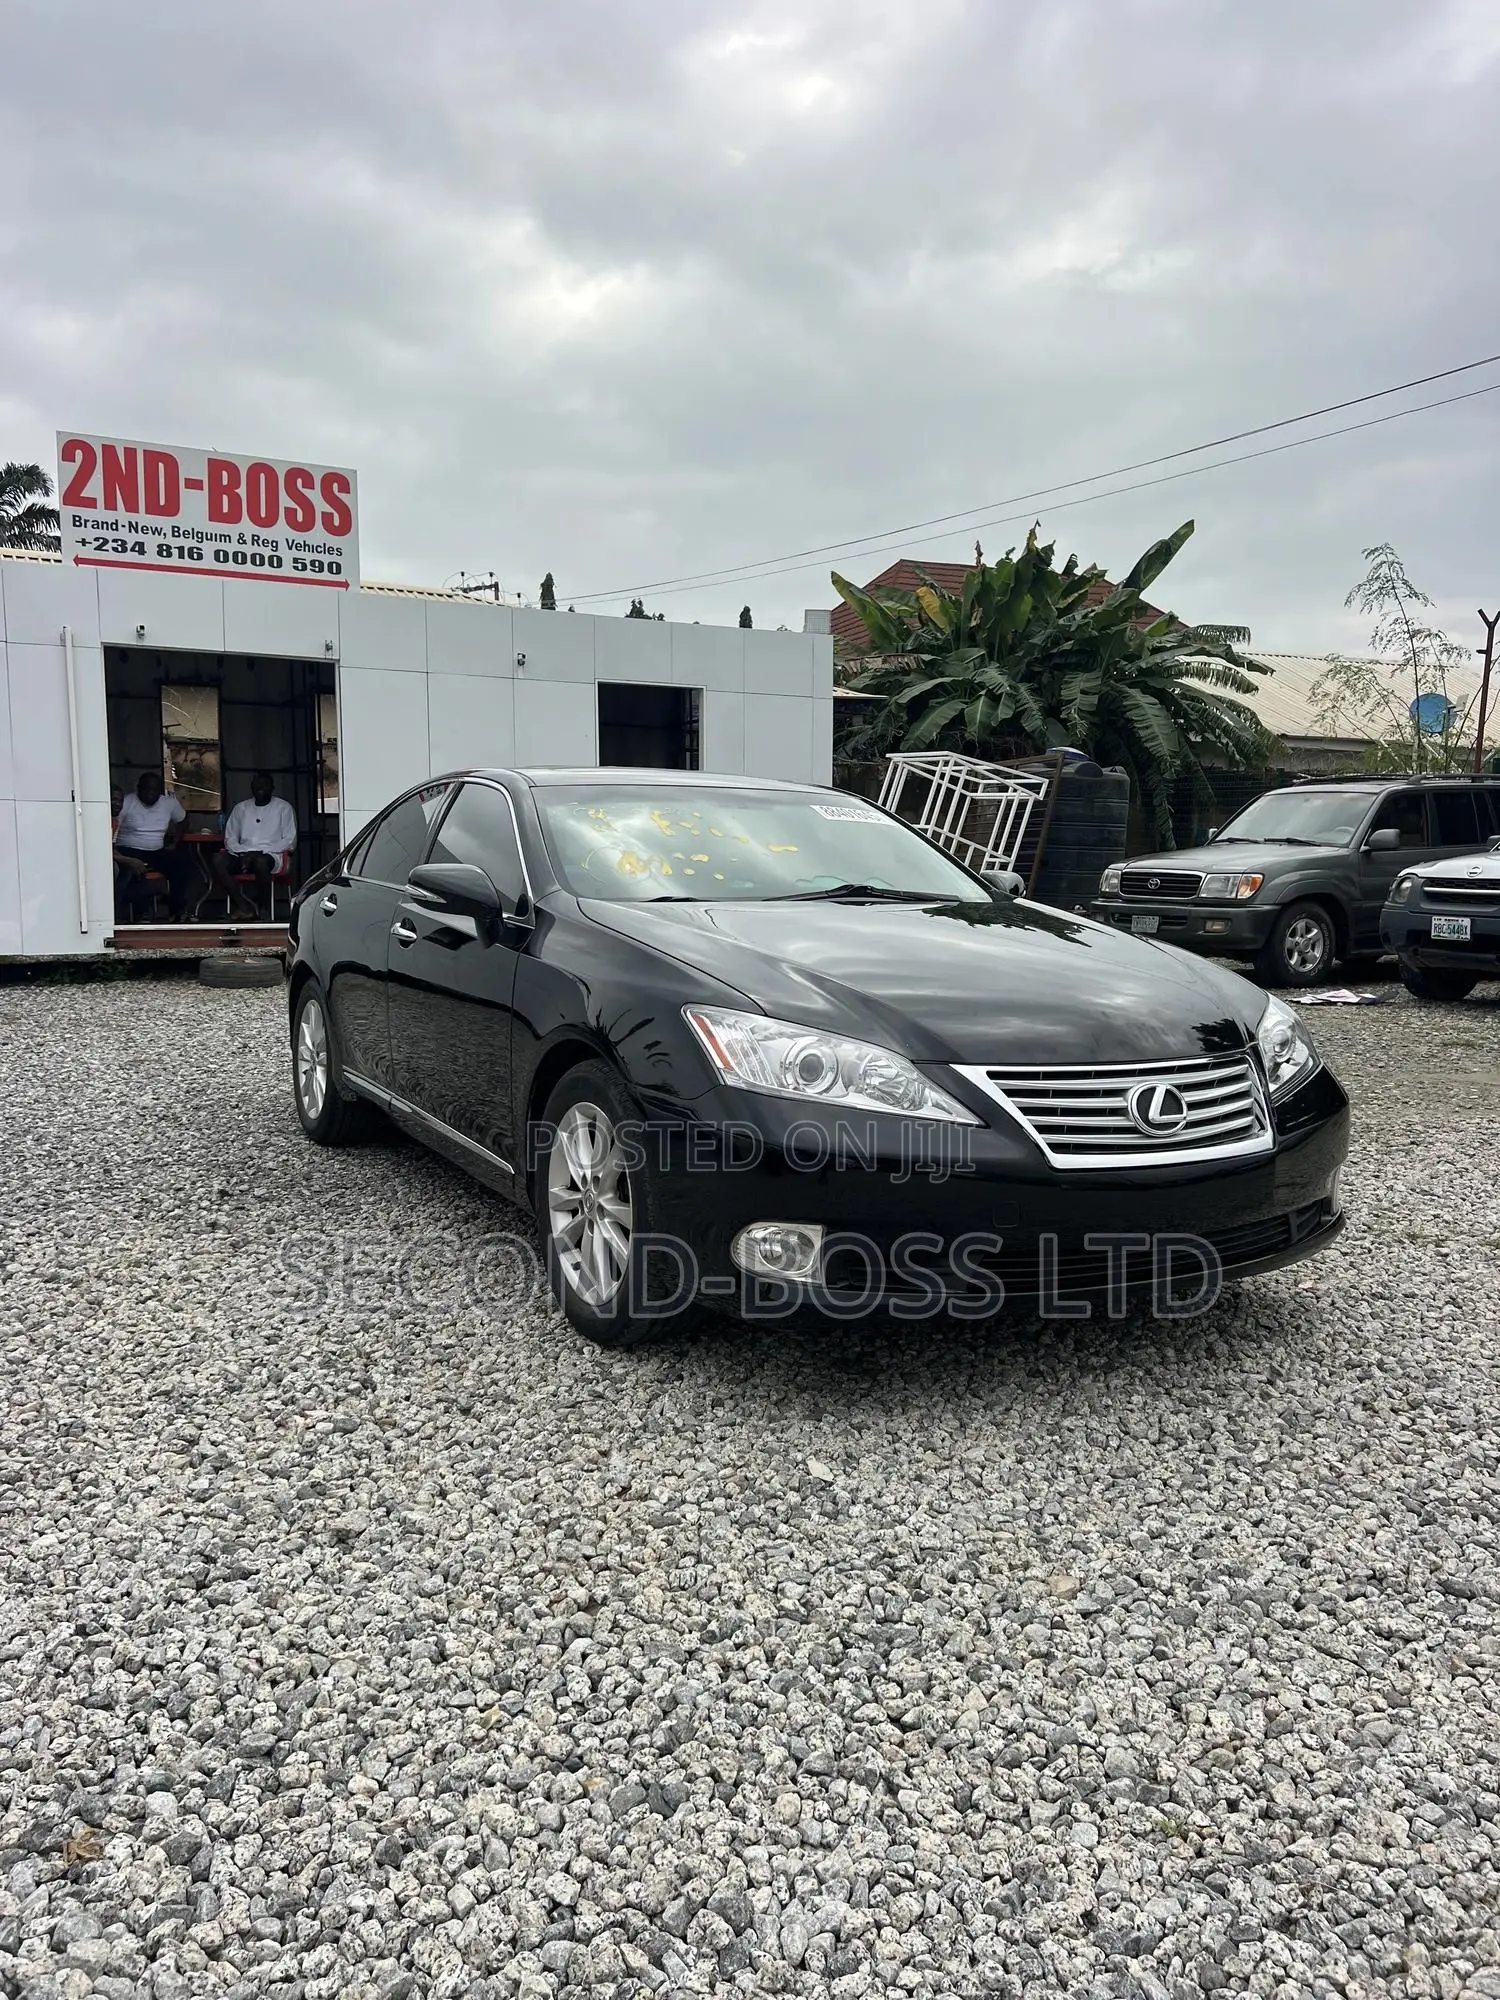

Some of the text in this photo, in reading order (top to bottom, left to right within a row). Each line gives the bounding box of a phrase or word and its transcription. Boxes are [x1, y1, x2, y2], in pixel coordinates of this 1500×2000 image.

[61, 438, 352, 537] 2ND-BOSS
[75, 537, 342, 575] +234 816 0000 590
[237, 532, 248, 545] &
[251, 533, 279, 553] Reg
[285, 538, 343, 557] Vehicles
